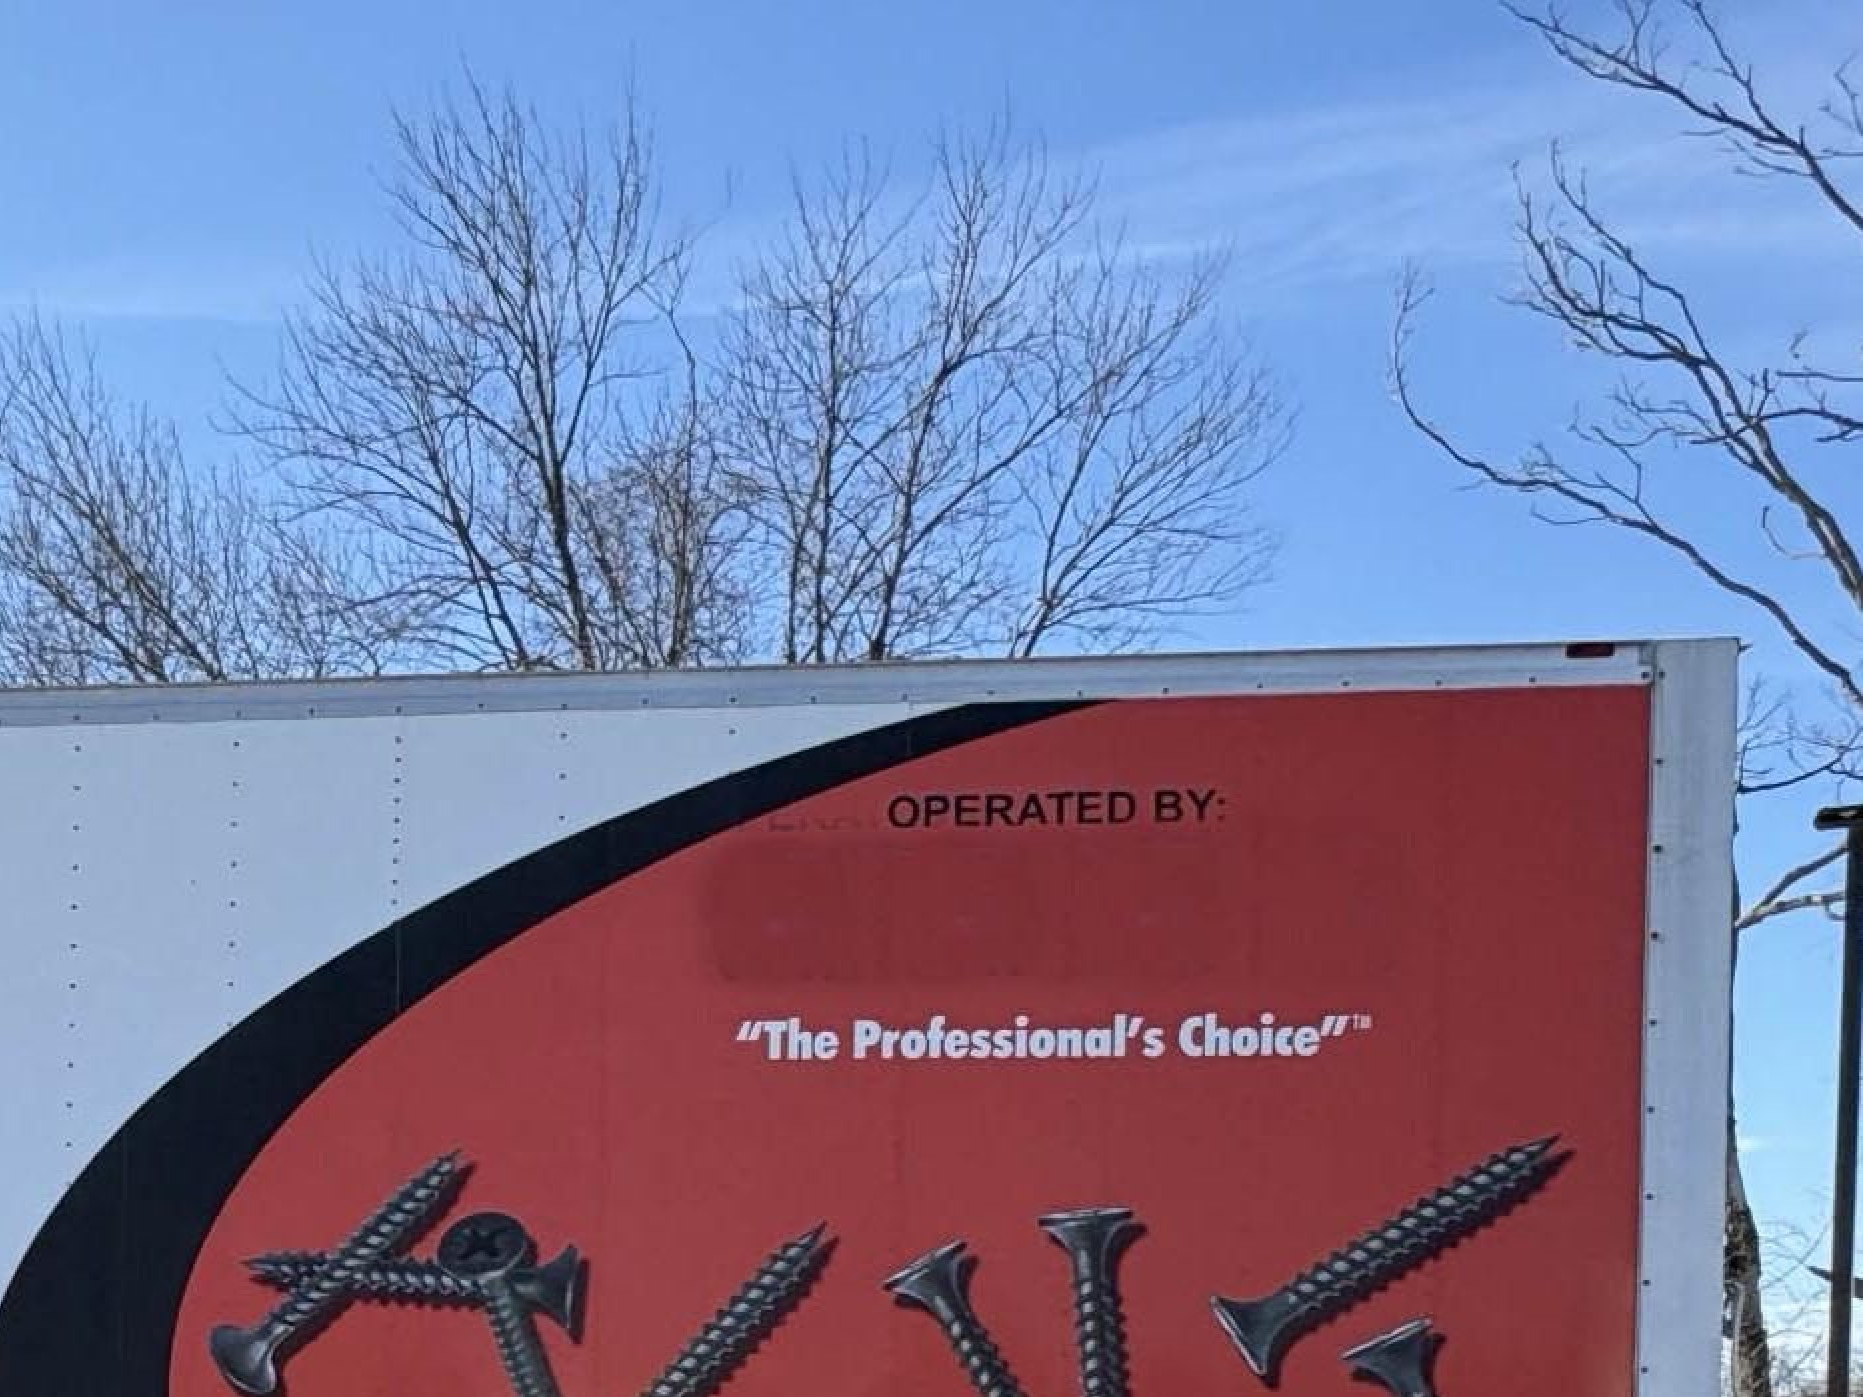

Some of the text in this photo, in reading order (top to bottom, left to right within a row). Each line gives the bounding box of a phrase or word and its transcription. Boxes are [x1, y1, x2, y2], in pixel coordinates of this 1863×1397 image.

[887, 791, 1136, 829] OPERATED
[1153, 789, 1227, 823] BY:
[852, 1013, 1166, 1060] Professional's
